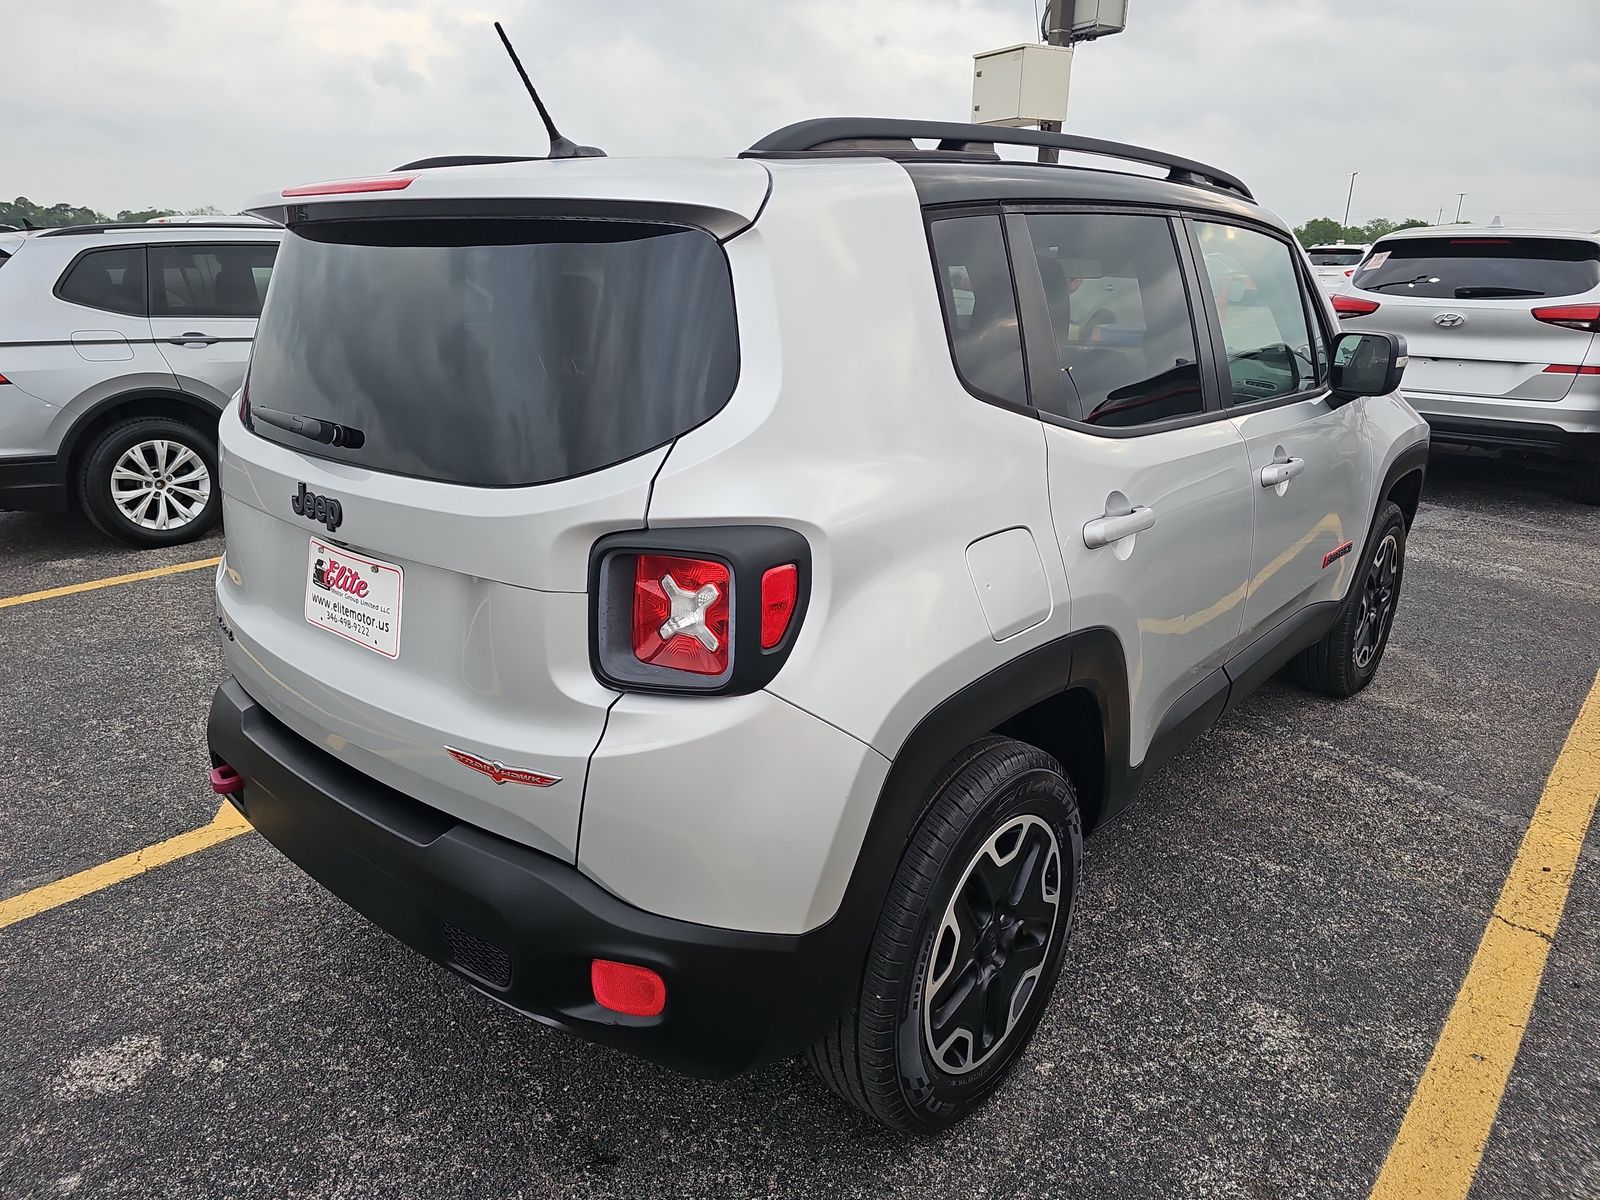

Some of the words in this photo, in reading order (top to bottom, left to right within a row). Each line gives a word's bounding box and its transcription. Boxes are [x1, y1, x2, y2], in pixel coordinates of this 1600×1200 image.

[291, 481, 343, 533] Jeep
[323, 557, 370, 598] Elite
[311, 592, 390, 633] www.elitemotor.us
[326, 610, 370, 637] 346-498-9222
[344, 593, 359, 604] Group
[360, 599, 379, 611] Limited
[380, 606, 391, 615] LLC
